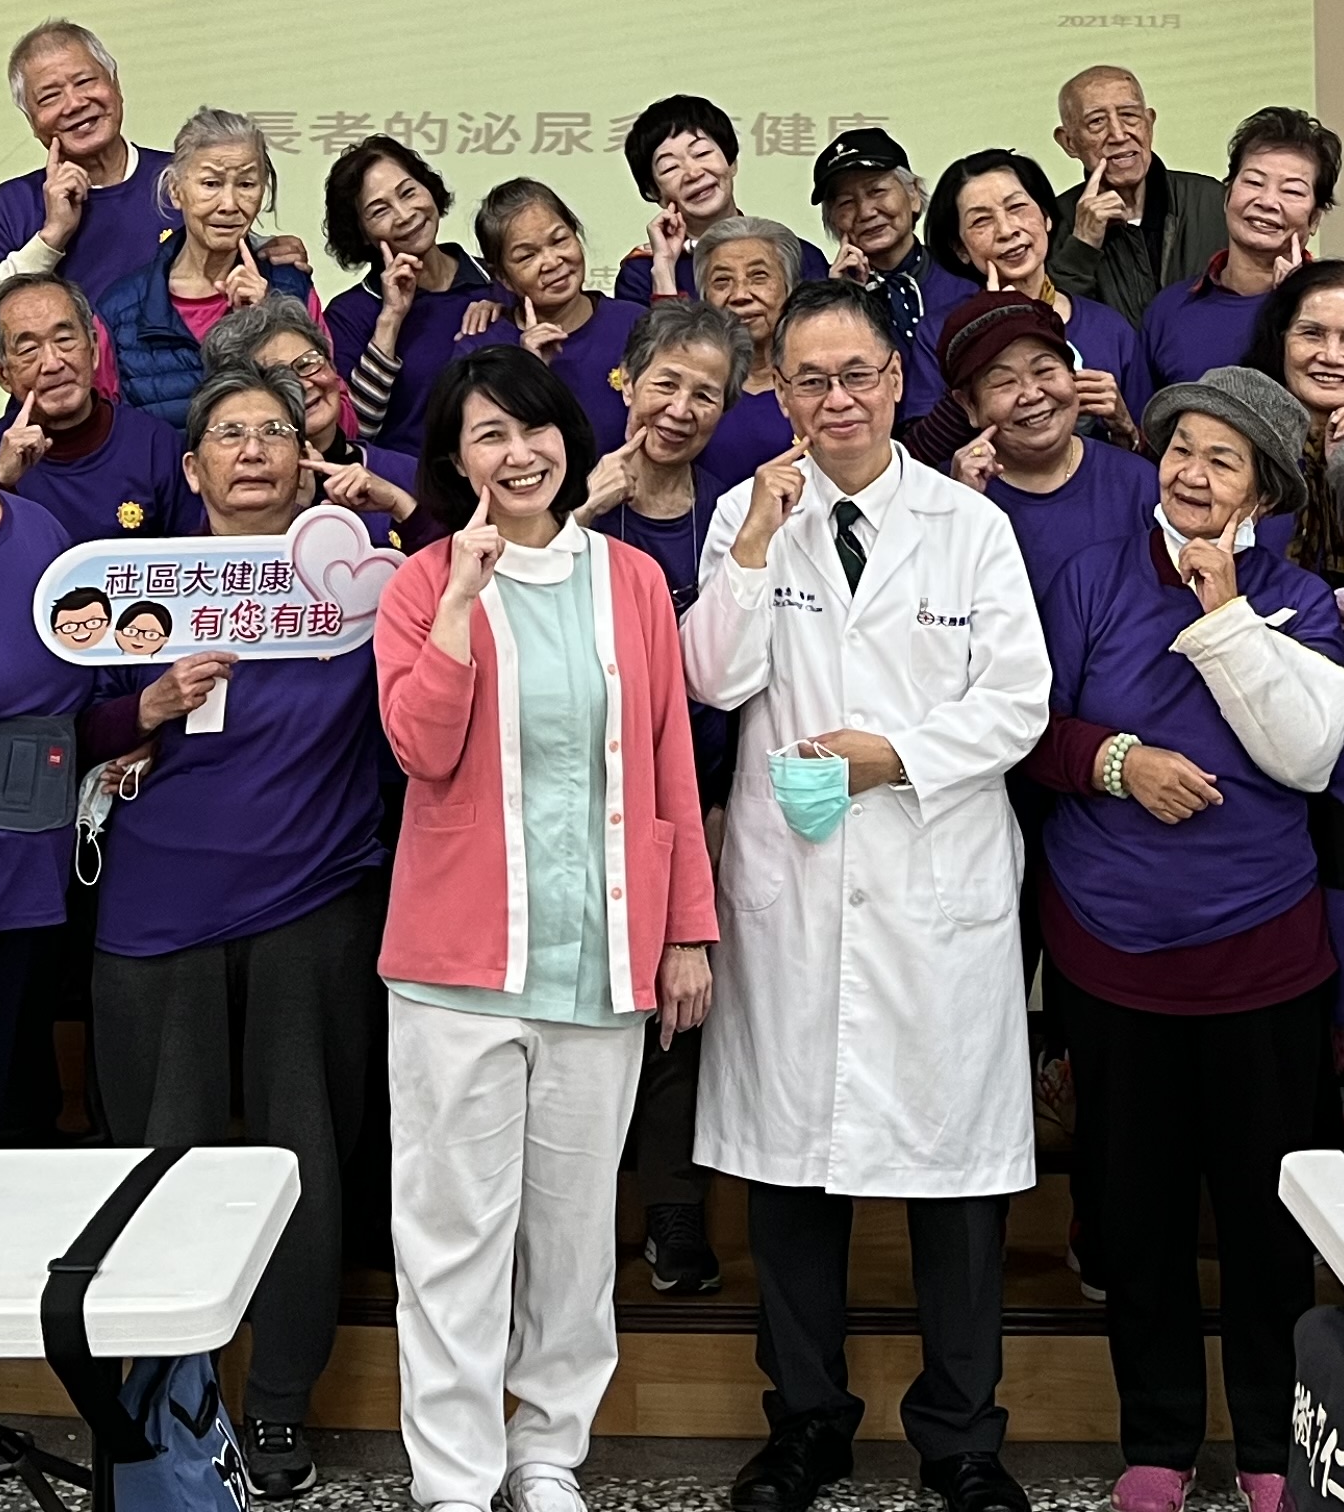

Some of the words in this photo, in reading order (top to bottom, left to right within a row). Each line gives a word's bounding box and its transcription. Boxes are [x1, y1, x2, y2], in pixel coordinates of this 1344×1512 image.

[1056, 13, 1181, 29] 2021年11月
[105, 559, 293, 596] 社區大健康
[190, 599, 341, 640] 有您有我
